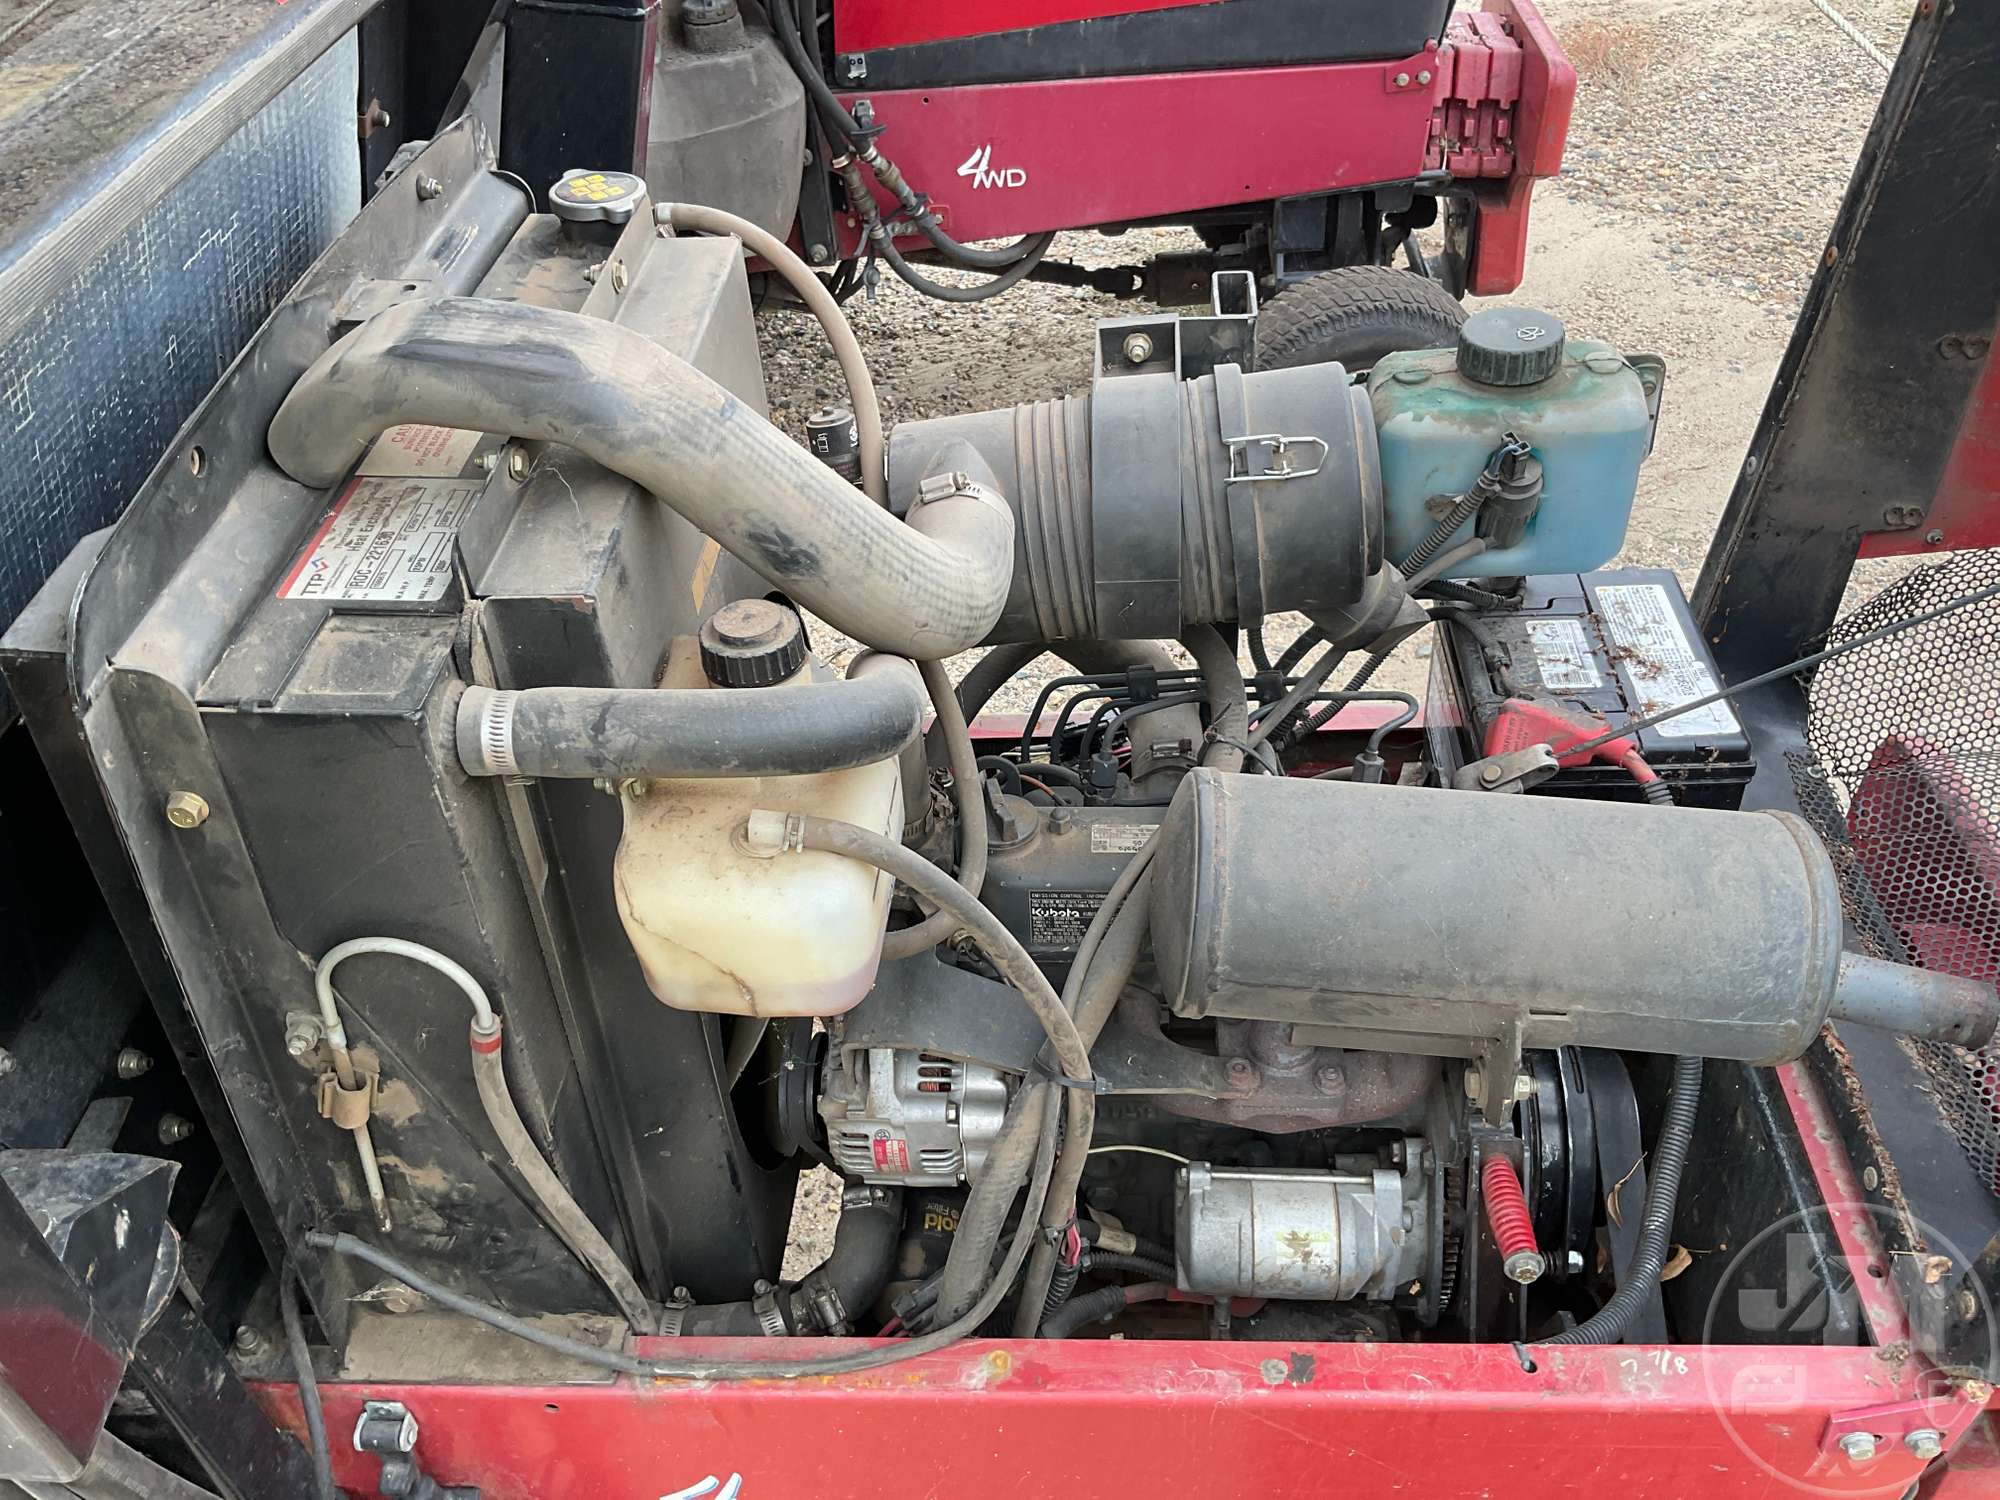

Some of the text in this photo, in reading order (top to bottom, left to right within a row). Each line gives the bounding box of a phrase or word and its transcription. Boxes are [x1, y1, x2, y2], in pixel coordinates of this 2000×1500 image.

[957, 144, 1026, 189] 4WD
[346, 534, 369, 551] Heat
[300, 574, 328, 595] TTP
[1032, 907, 1080, 918] Kubota
